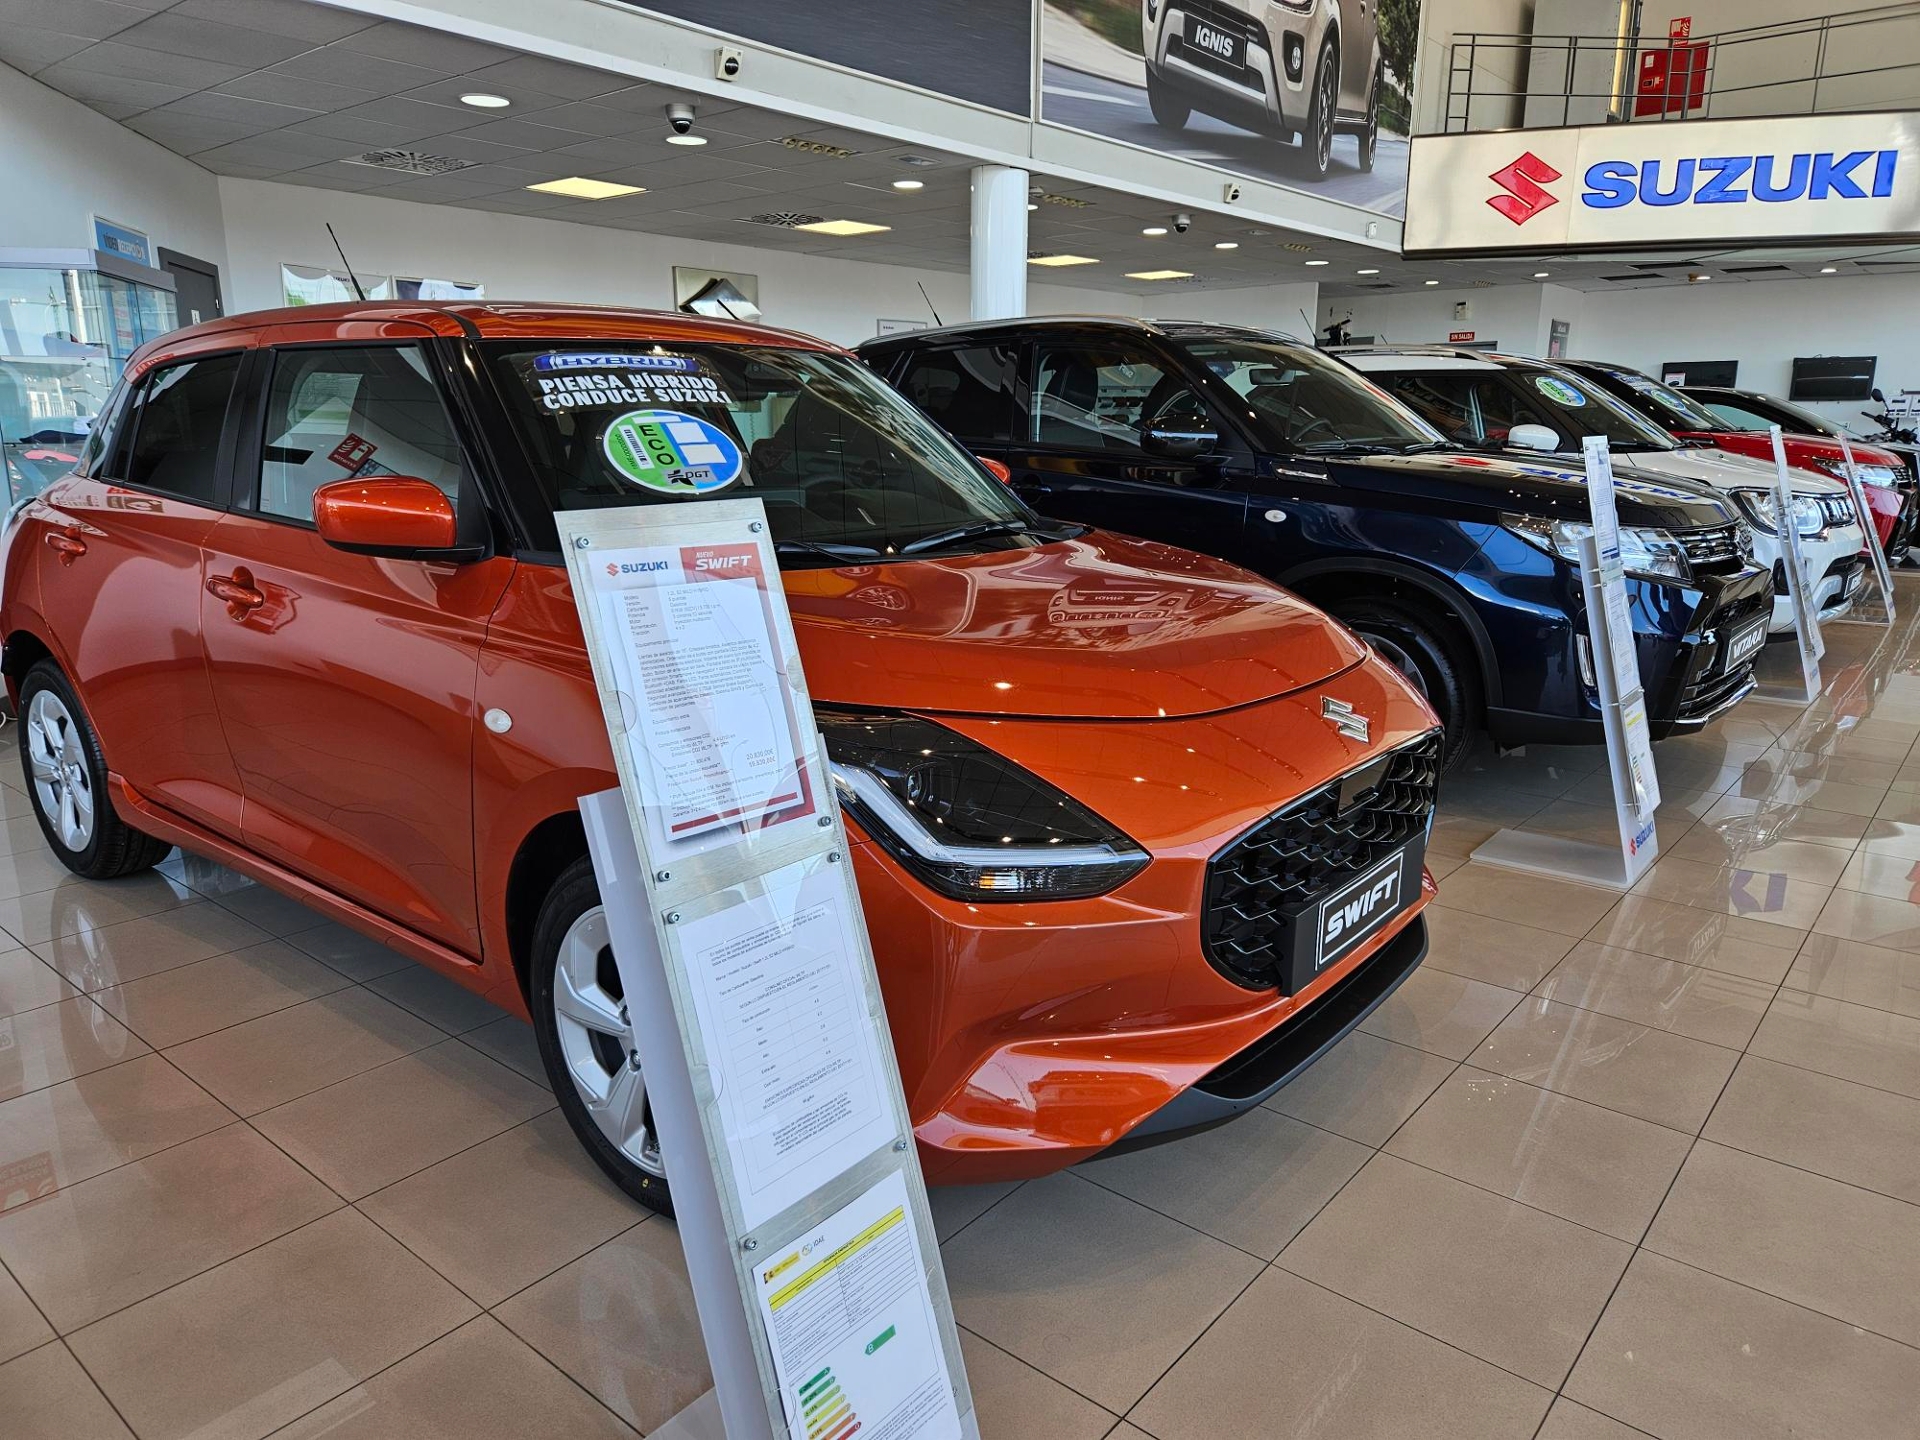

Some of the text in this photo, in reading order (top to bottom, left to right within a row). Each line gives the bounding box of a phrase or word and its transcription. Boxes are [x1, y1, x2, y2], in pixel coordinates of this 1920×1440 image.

[1194, 24, 1234, 58] IGNIS
[1581, 149, 1898, 208] SUZUKI
[560, 356, 678, 367] HYBRID
[538, 372, 718, 394] PIENSA HÍBRIDO
[543, 388, 732, 409] CONDUCE SUZUKI
[639, 424, 675, 466] ECO
[685, 470, 710, 479] DGT
[621, 561, 669, 574] SUZUKI
[695, 555, 753, 570] SWIFT
[1733, 626, 1764, 659] VITARA
[1635, 820, 1655, 850] SUZUKI
[1324, 870, 1398, 944] SWIFT
[868, 1343, 874, 1353] B
